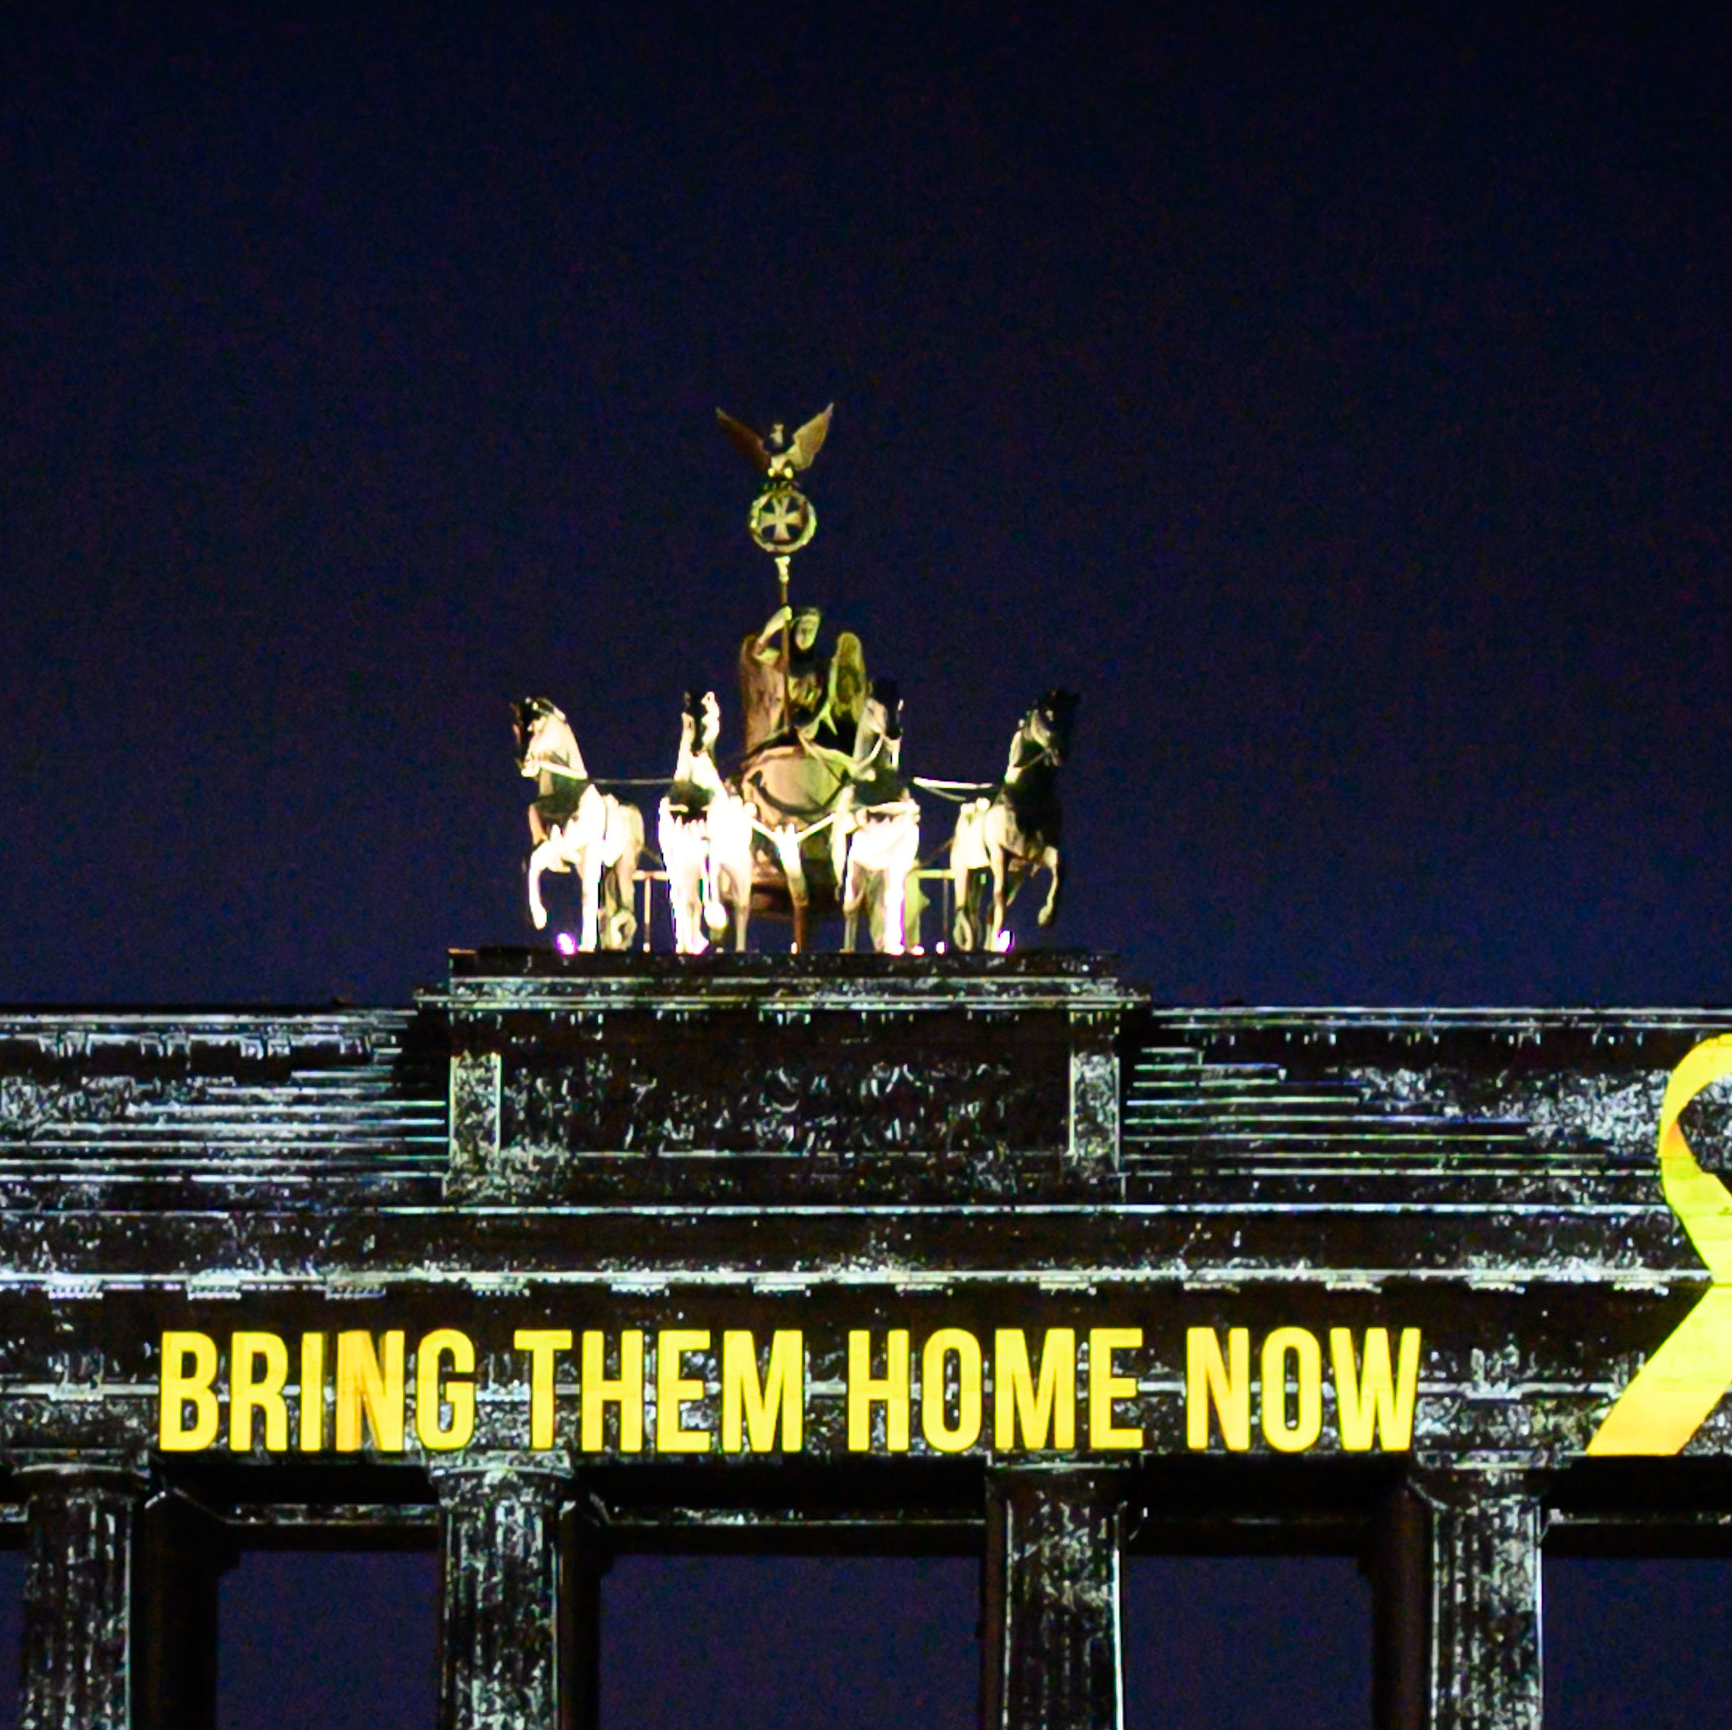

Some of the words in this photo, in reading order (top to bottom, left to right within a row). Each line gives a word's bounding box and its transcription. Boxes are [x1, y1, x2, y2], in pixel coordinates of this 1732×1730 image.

[158, 1329, 478, 1453] BRING
[513, 1328, 804, 1453] THEM
[847, 1327, 1145, 1453] HOME
[1184, 1326, 1422, 1453] NOW
